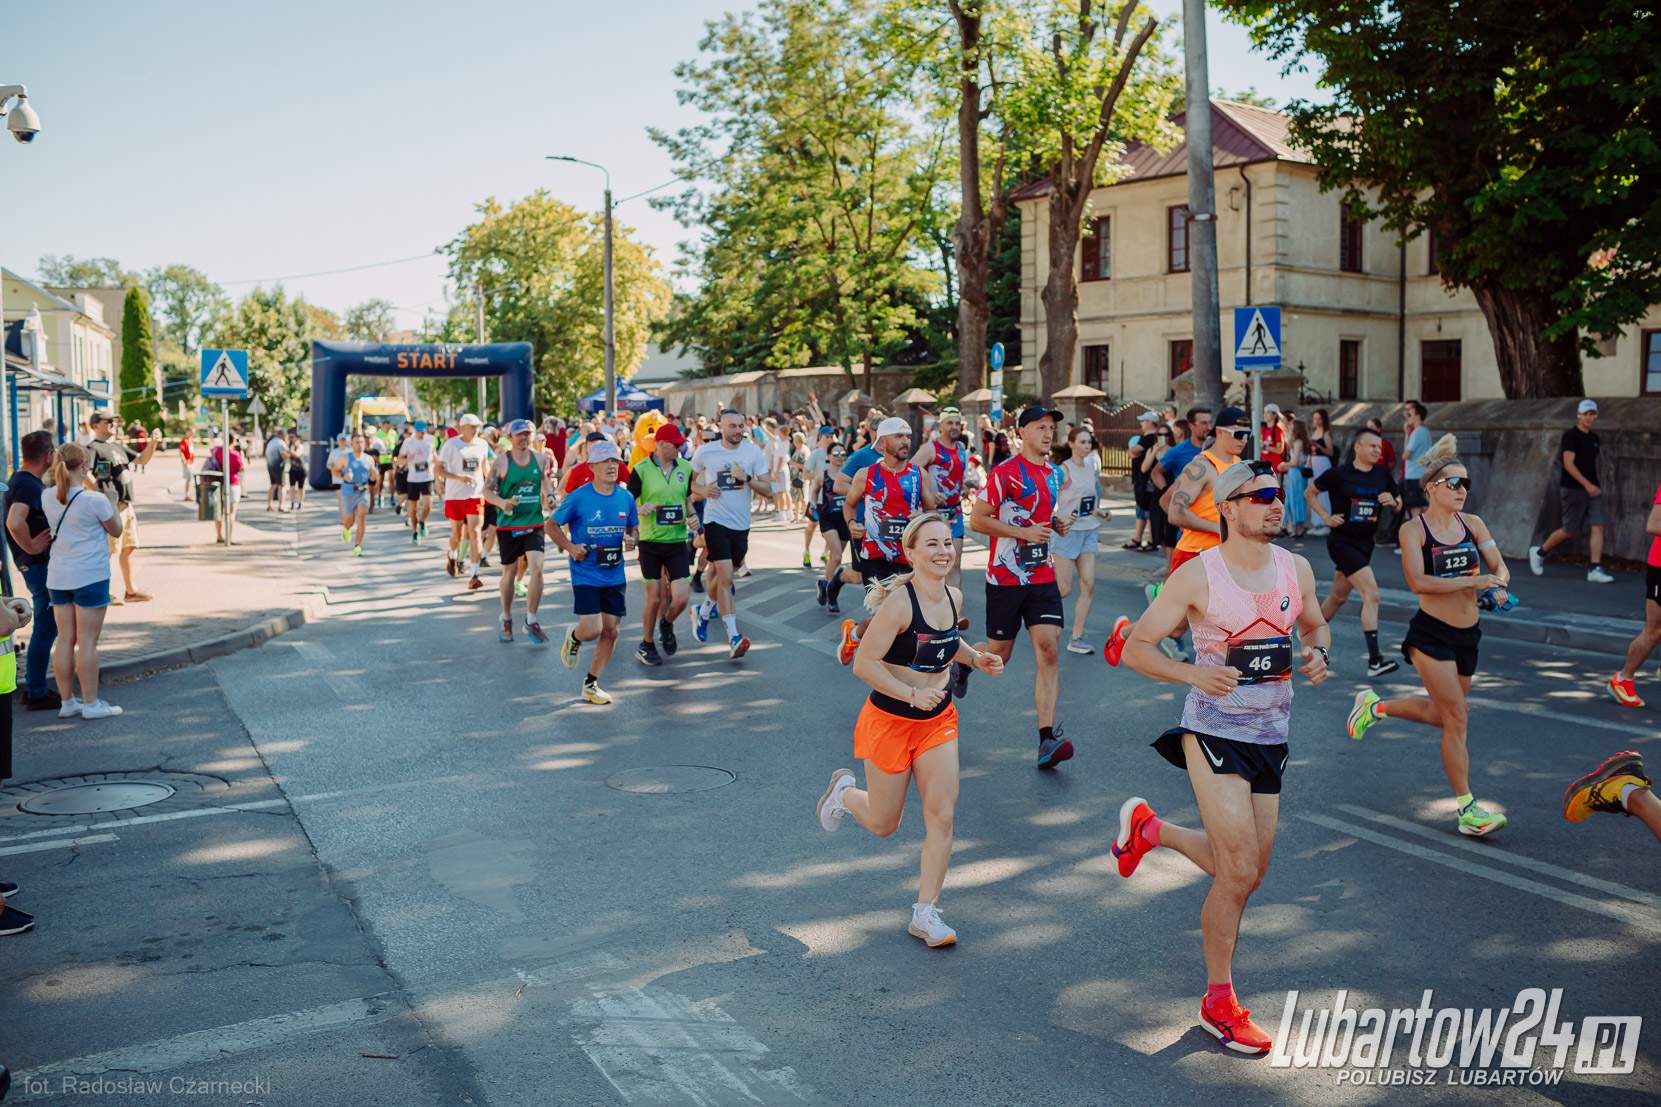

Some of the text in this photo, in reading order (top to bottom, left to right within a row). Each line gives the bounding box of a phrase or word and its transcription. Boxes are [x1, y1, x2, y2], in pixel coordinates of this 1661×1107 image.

[397, 352, 458, 369] START
[665, 512, 676, 520] 83
[606, 552, 618, 562] 64
[1031, 548, 1044, 558] 51
[1445, 556, 1468, 570] 123
[936, 648, 945, 660] 4
[1249, 655, 1272, 671] 46
